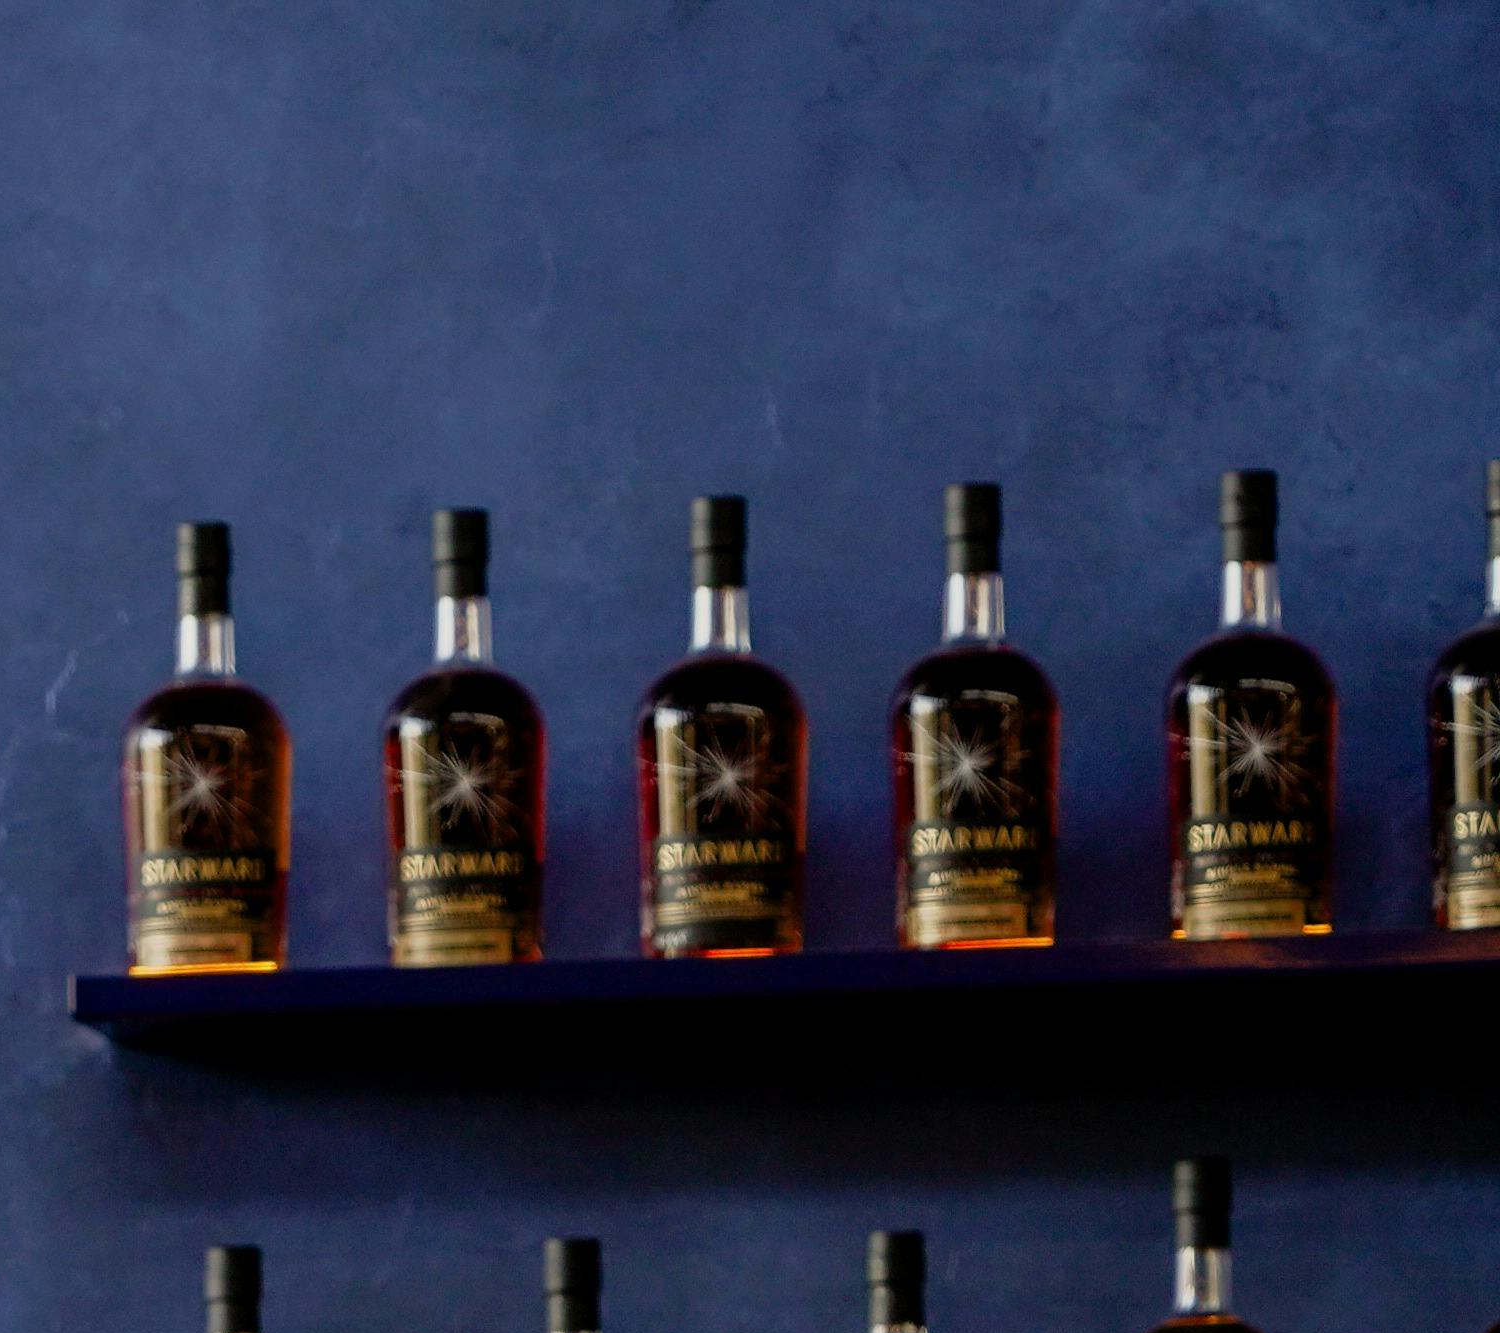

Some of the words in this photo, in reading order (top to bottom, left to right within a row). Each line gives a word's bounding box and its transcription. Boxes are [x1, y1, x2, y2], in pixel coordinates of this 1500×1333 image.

[1188, 820, 1316, 852] STARWAR
[1453, 809, 1500, 840] STA
[657, 839, 783, 871] STARWAR
[911, 825, 1038, 856] STARWAR
